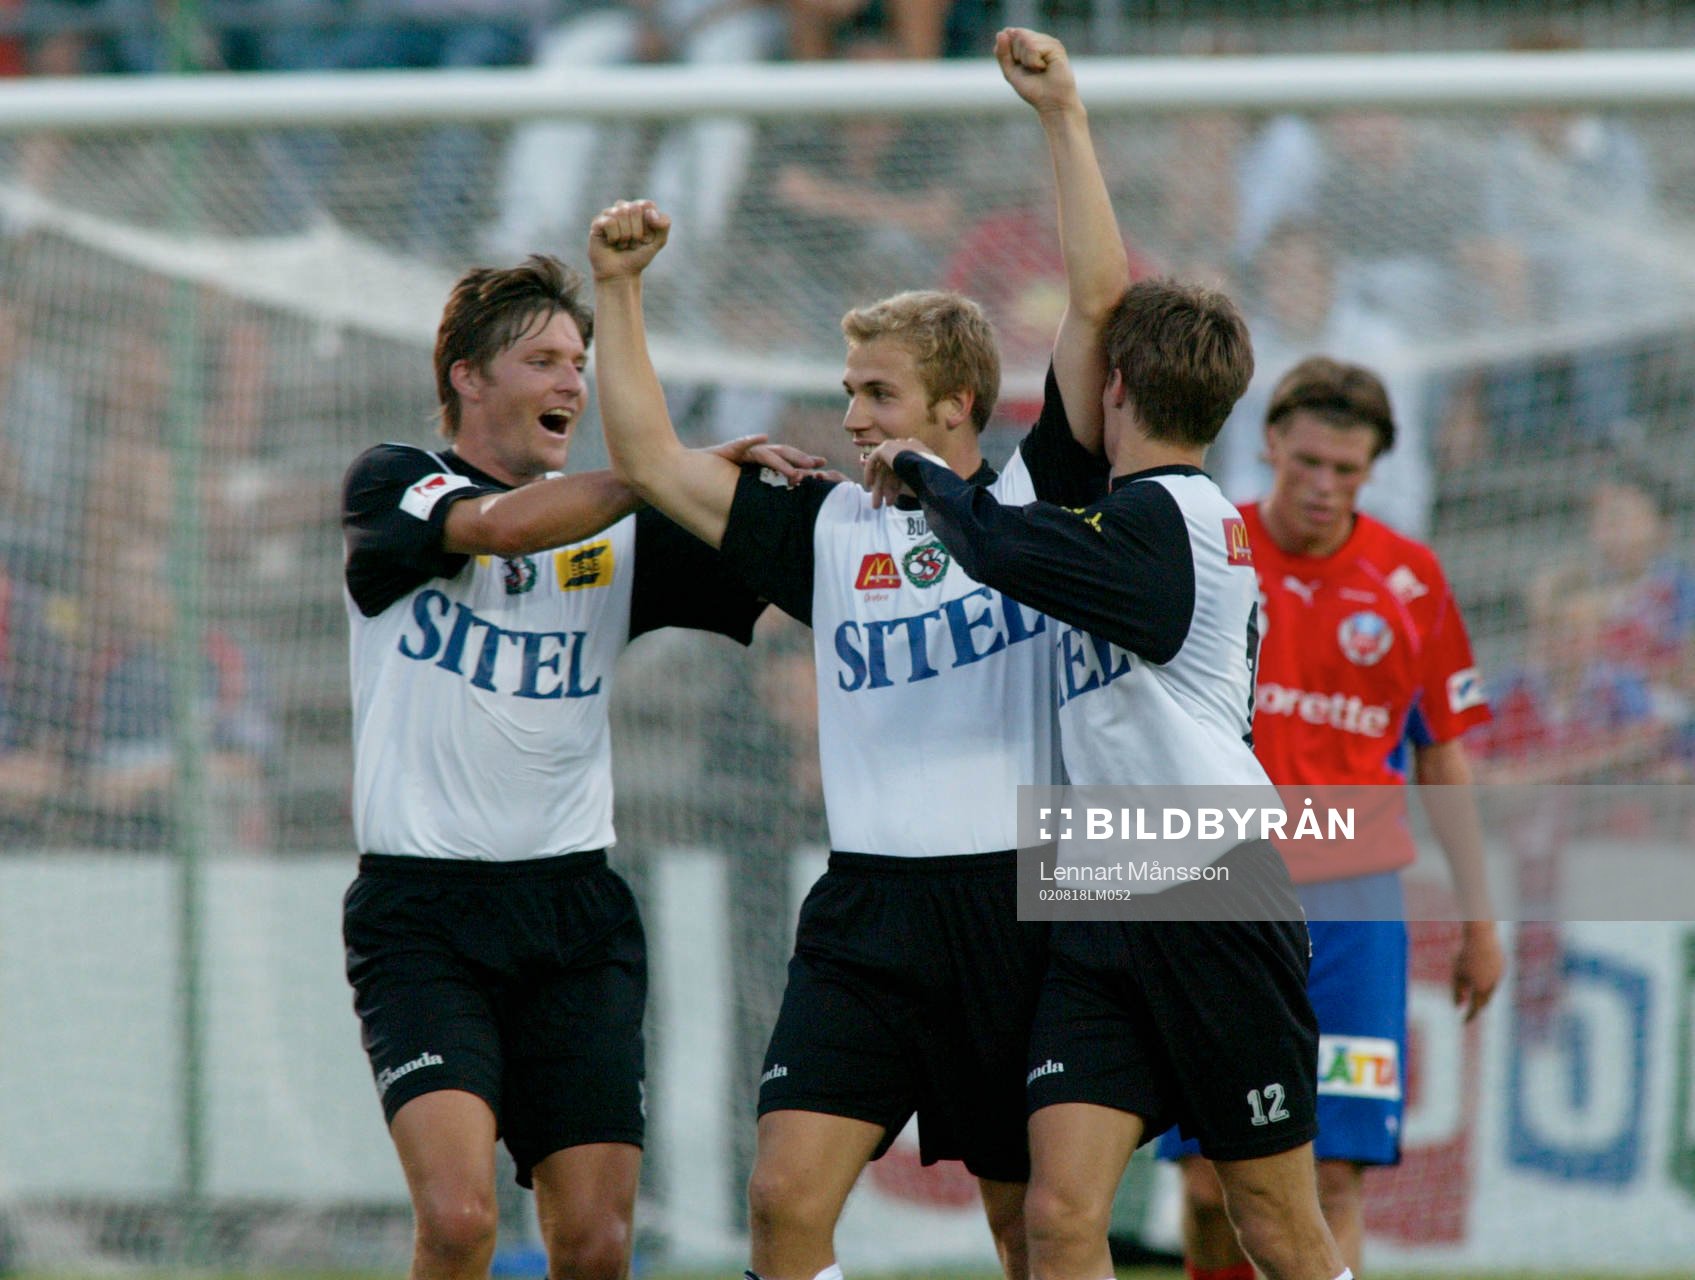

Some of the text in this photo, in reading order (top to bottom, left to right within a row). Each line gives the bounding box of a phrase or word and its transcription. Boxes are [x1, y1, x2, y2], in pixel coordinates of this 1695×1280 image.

[398, 588, 602, 700] SITEL
[834, 585, 1046, 693] SITEL
[1246, 1082, 1290, 1127] 12
